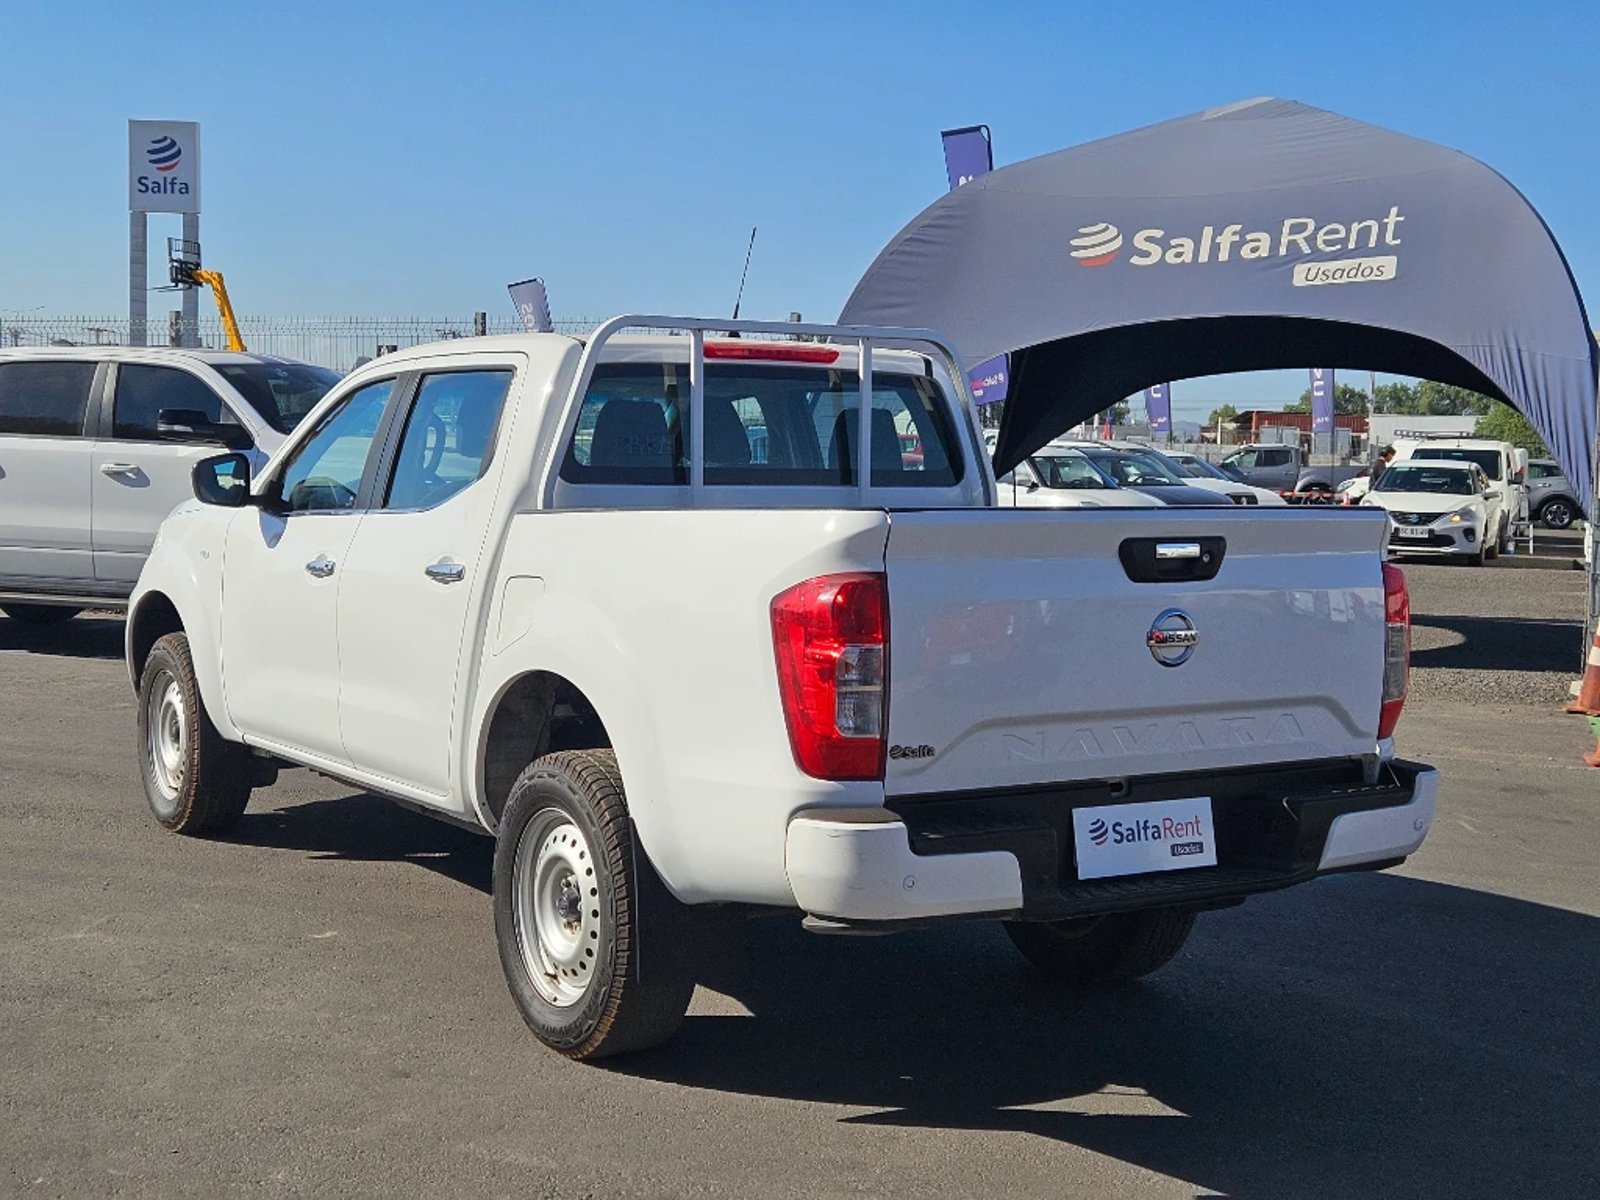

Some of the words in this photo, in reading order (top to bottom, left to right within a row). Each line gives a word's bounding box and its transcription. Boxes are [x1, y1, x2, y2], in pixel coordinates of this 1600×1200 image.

[137, 176, 189, 194] Salfa
[1304, 262, 1386, 282] Usados
[1001, 713, 1305, 762] NAVARA
[902, 745, 936, 759] Salfa
